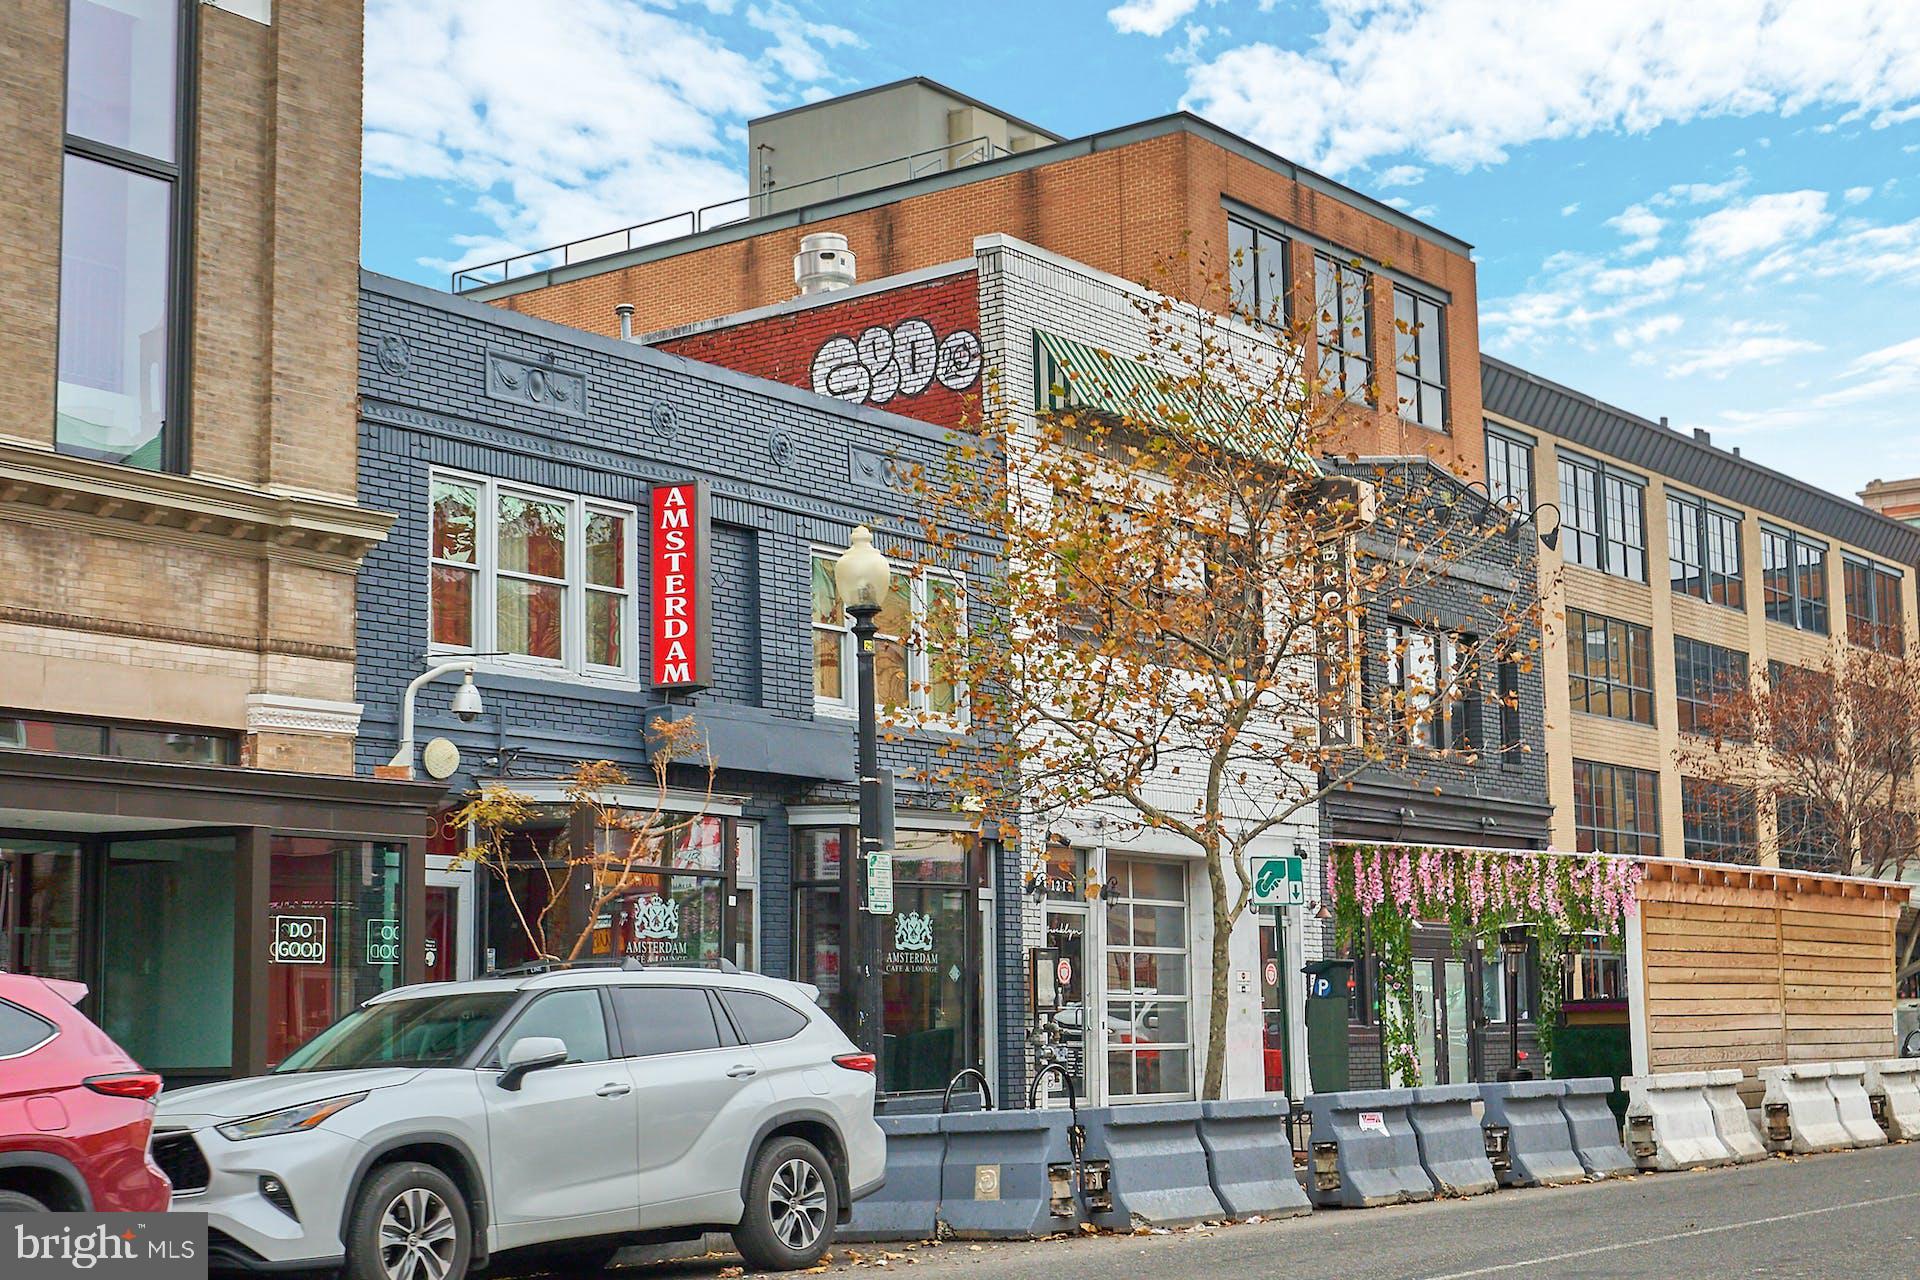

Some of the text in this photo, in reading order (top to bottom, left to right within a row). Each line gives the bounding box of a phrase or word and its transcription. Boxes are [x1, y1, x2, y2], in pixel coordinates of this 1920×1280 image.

[660, 487, 691, 684] AMSTERDAM
[289, 922, 313, 938] DO
[278, 941, 323, 957] GOOD
[626, 941, 687, 954] AMSTERDAM
[886, 952, 938, 964] AMSTERDAM
[912, 965, 938, 973] LOUNGE
